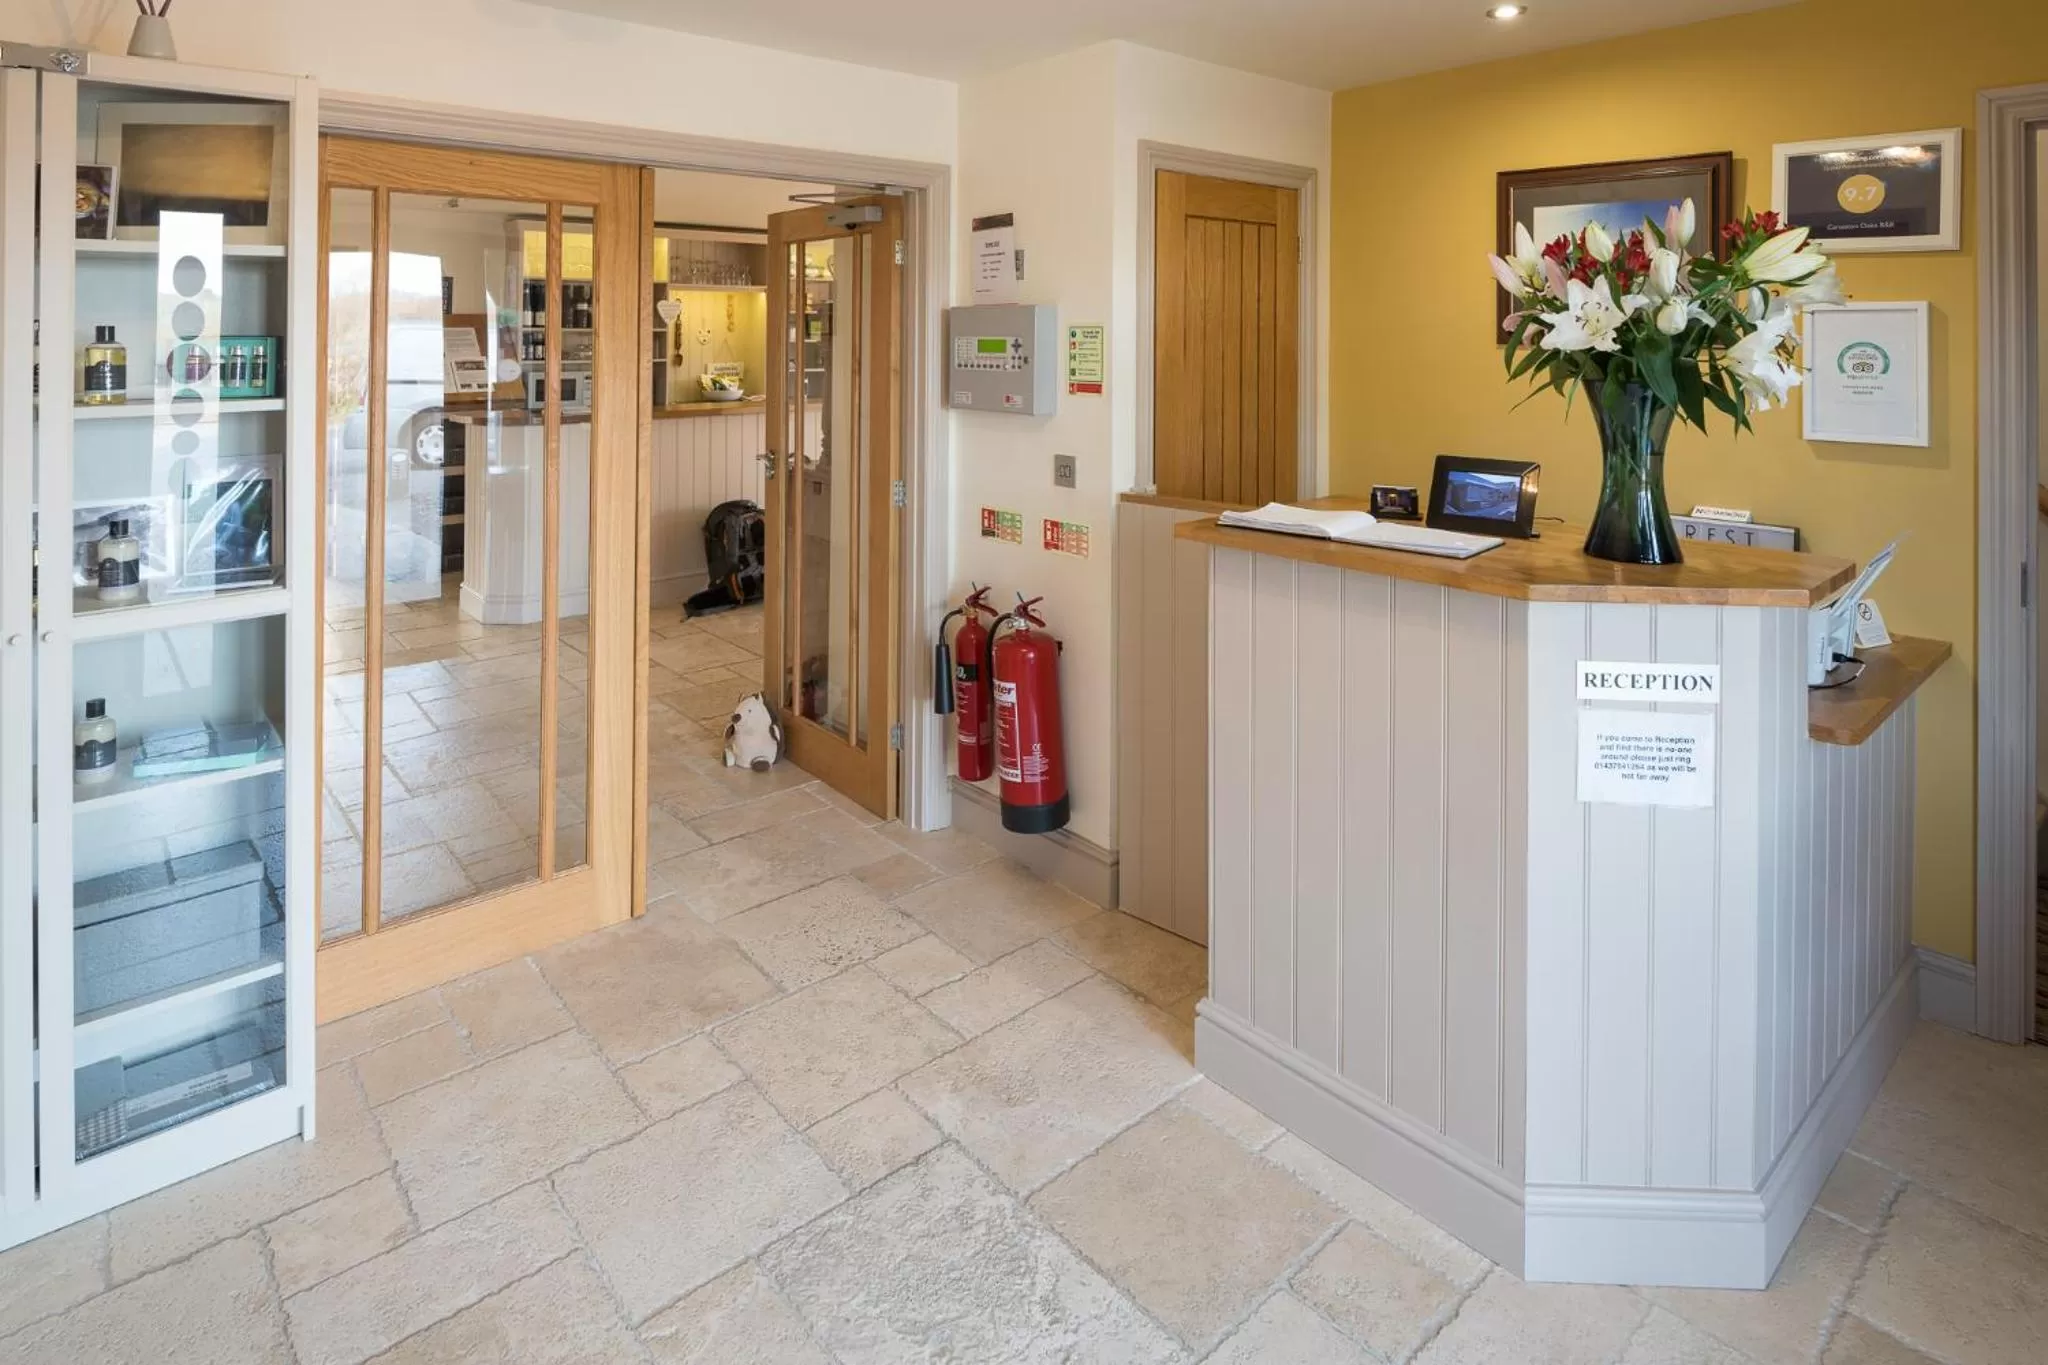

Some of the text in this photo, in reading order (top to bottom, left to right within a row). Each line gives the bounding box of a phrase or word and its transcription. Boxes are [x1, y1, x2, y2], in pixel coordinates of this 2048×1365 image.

[1843, 186, 1877, 201] 9.7
[1584, 672, 1713, 691] RECEPTION
[1605, 735, 1620, 743] you
[1655, 736, 1695, 745] Reception
